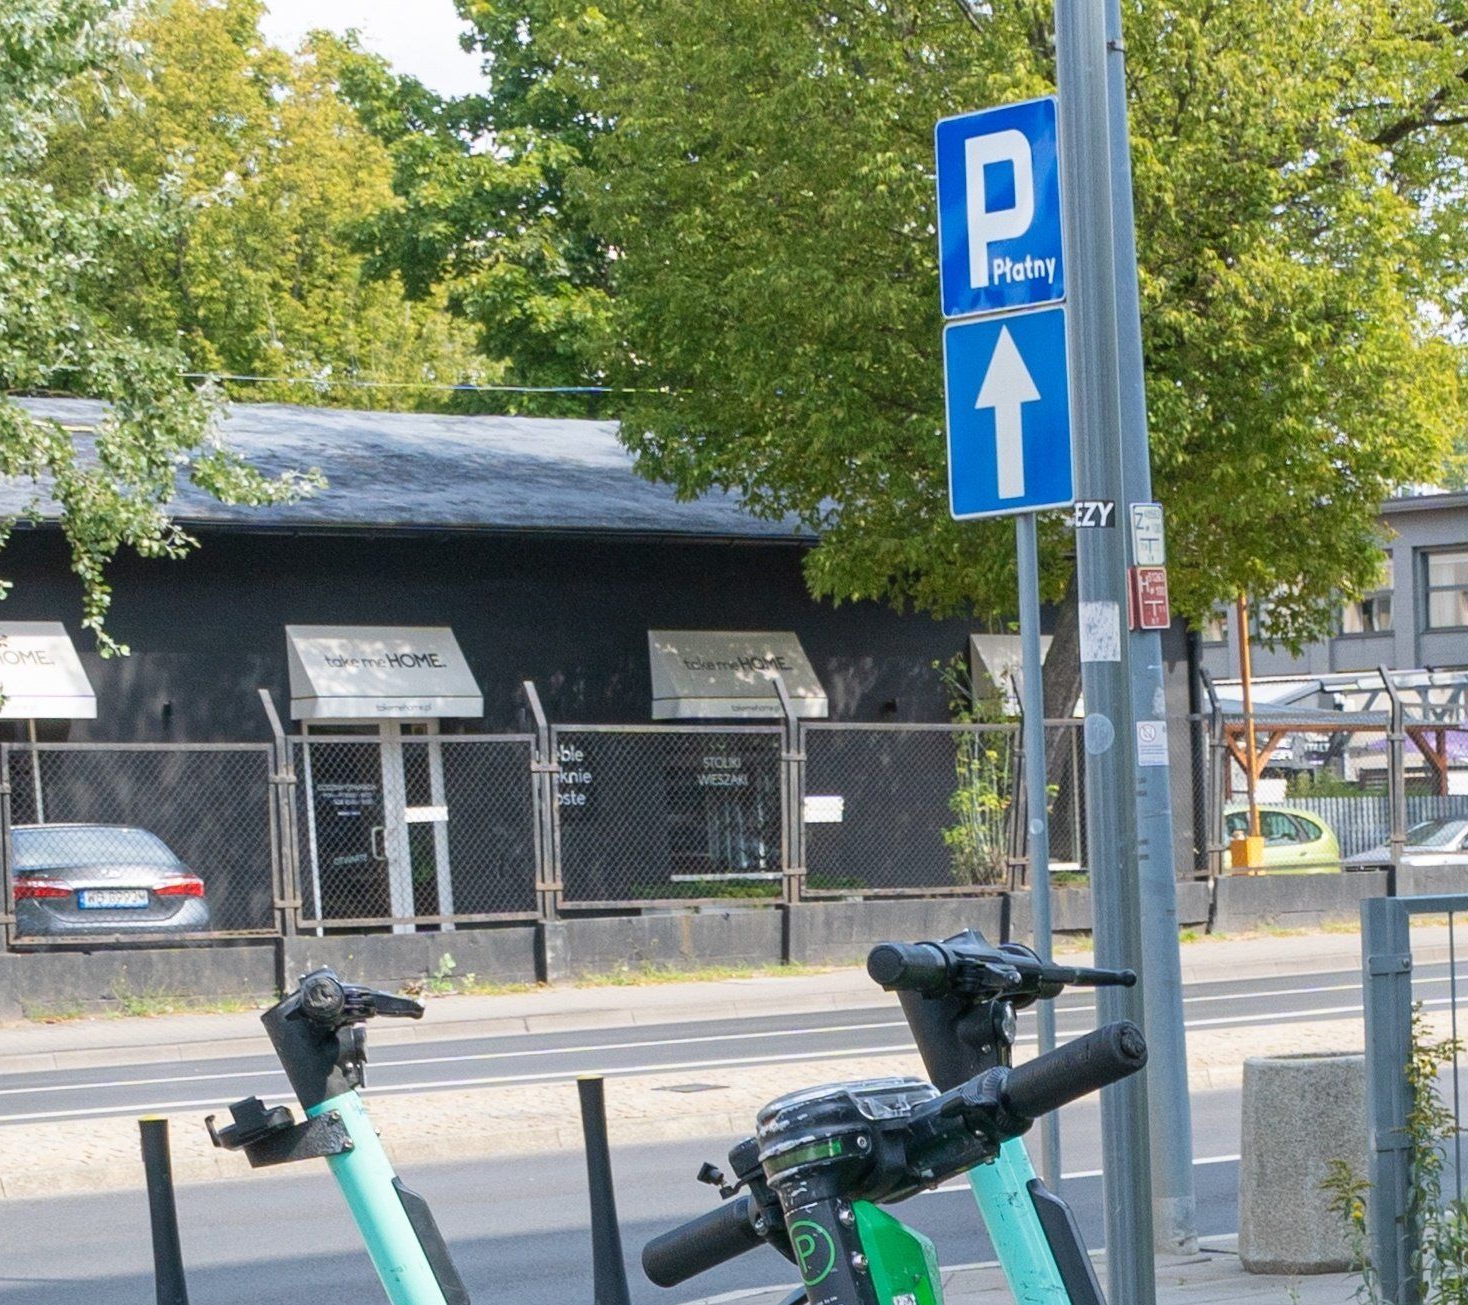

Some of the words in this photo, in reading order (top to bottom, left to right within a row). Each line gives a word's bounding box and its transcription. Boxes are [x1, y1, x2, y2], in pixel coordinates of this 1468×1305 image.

[965, 129, 1035, 289] P
[993, 254, 1056, 285] Płatny
[385, 653, 447, 668] HOME.
[737, 656, 793, 671] HOME.
